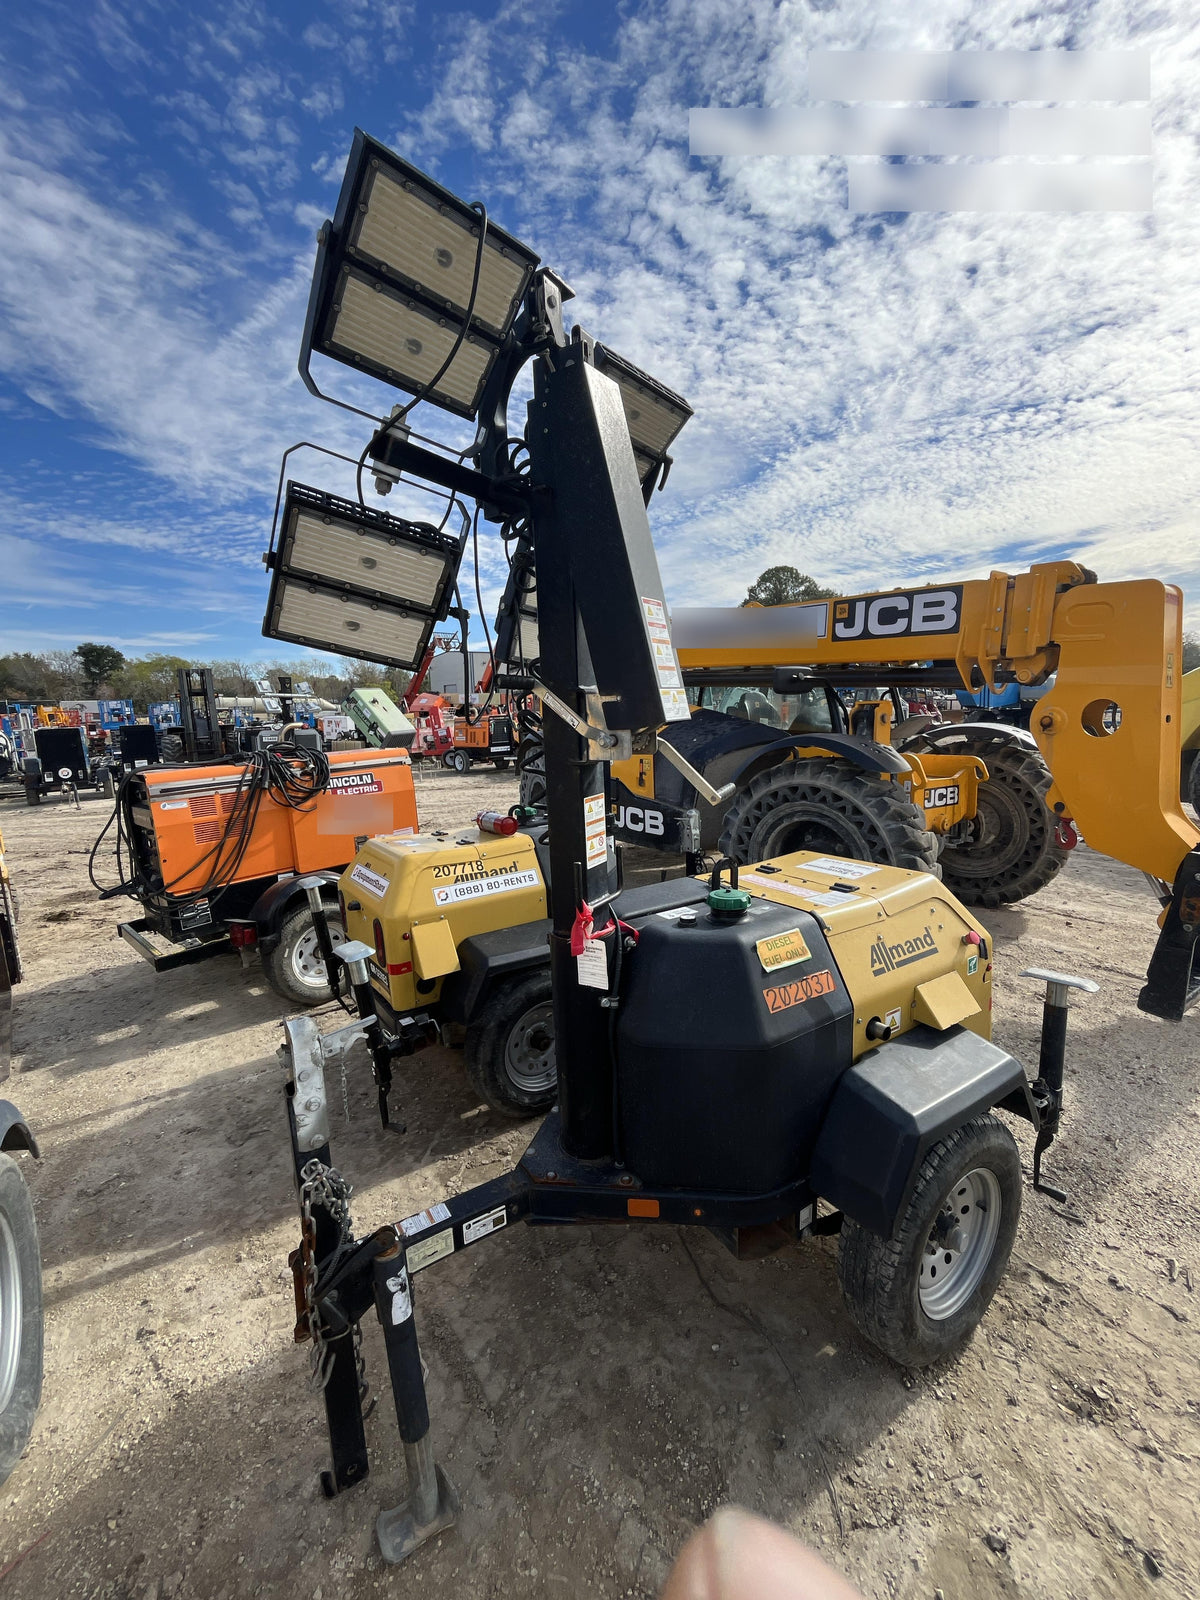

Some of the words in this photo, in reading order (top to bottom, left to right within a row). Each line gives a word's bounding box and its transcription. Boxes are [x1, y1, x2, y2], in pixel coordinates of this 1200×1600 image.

[835, 591, 957, 638] JCB
[327, 774, 372, 788] INCOLN
[337, 784, 378, 795] ELECTRIC
[924, 786, 958, 808] JCB
[615, 805, 664, 835] JCB
[433, 860, 484, 878] 207718
[454, 883, 484, 897] (888)
[486, 874, 534, 890] 80-RENTS
[765, 936, 794, 951] DIESEL
[870, 926, 936, 973] Allmand
[764, 953, 784, 967] FUEL
[786, 946, 806, 960] ONLY
[766, 971, 831, 1012] 202037
